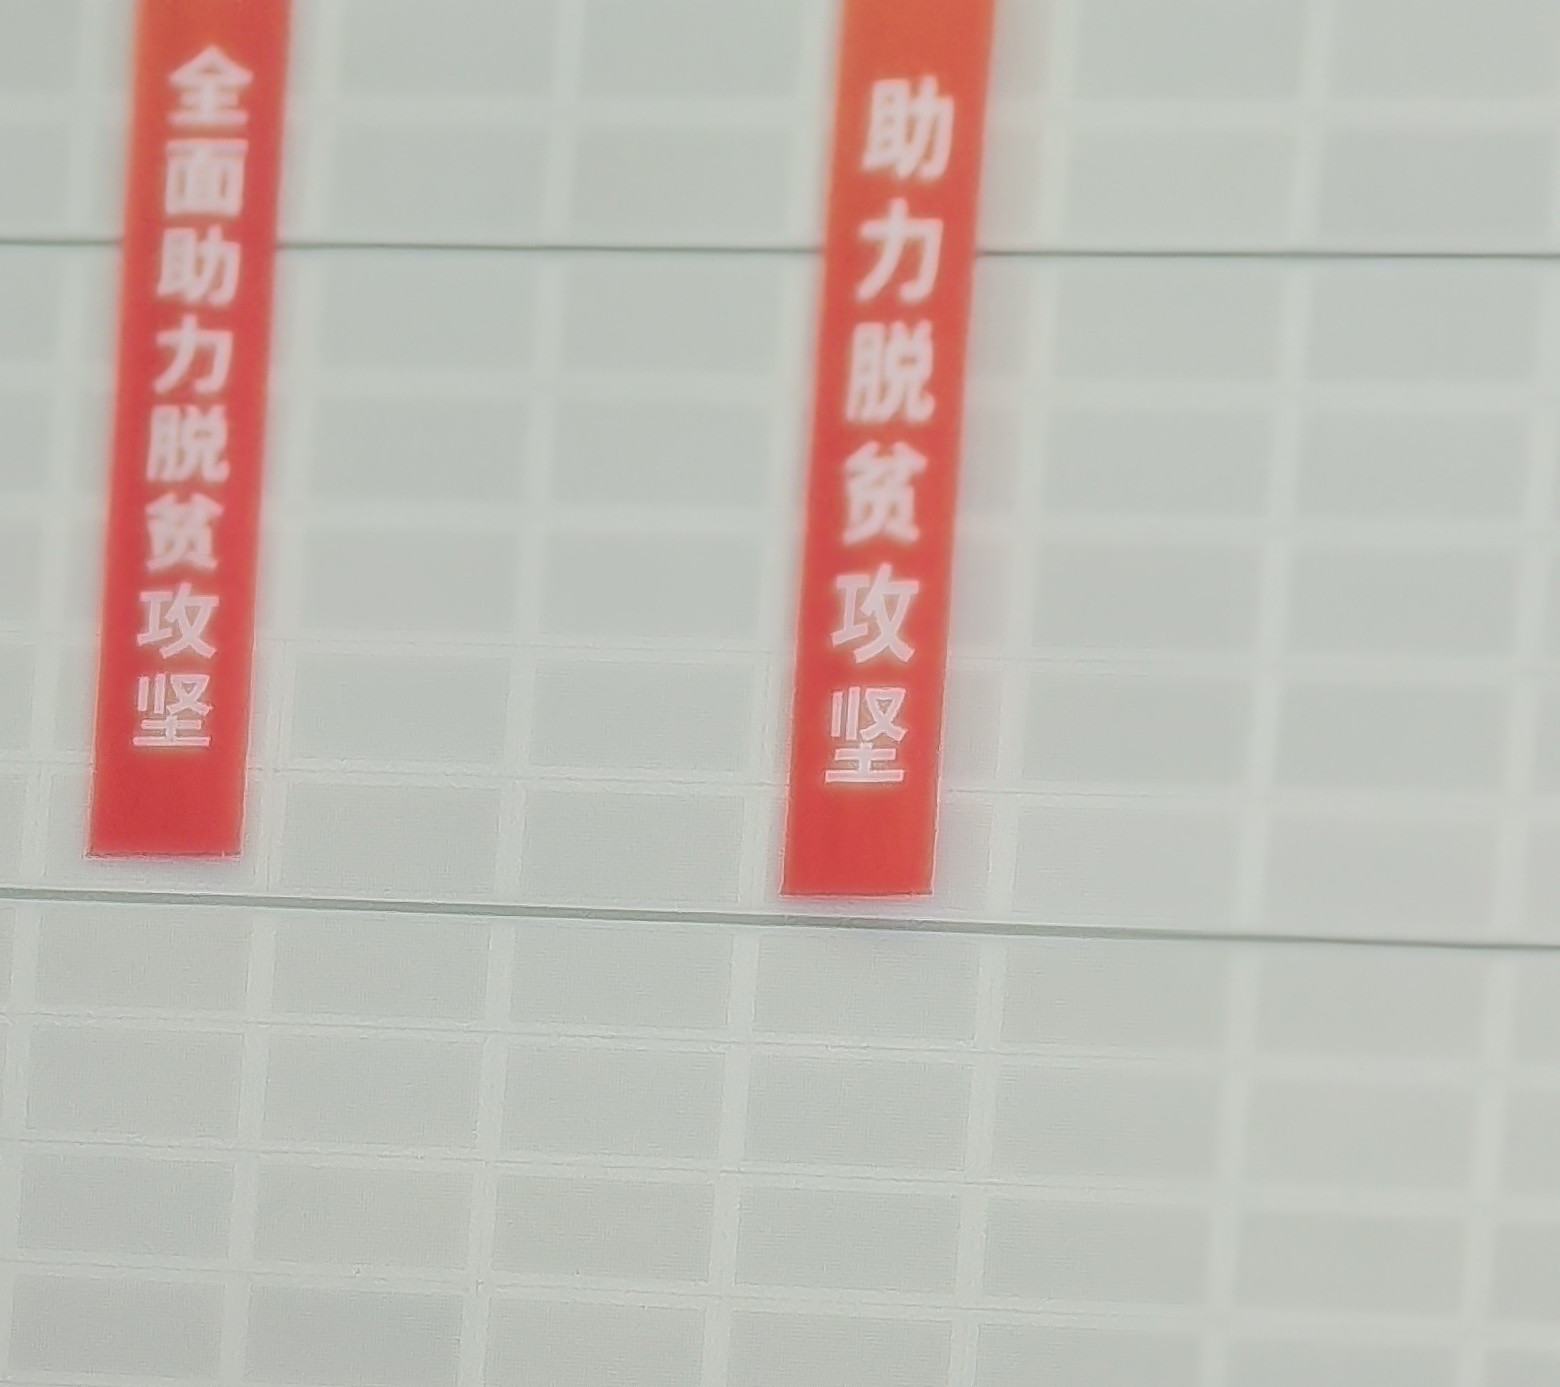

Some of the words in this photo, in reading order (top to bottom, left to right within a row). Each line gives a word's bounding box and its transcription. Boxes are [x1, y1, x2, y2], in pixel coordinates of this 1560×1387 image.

[132, 46, 253, 749] 全面助力脱贫攻坚
[823, 77, 955, 784] 助力脱贫攻坚
